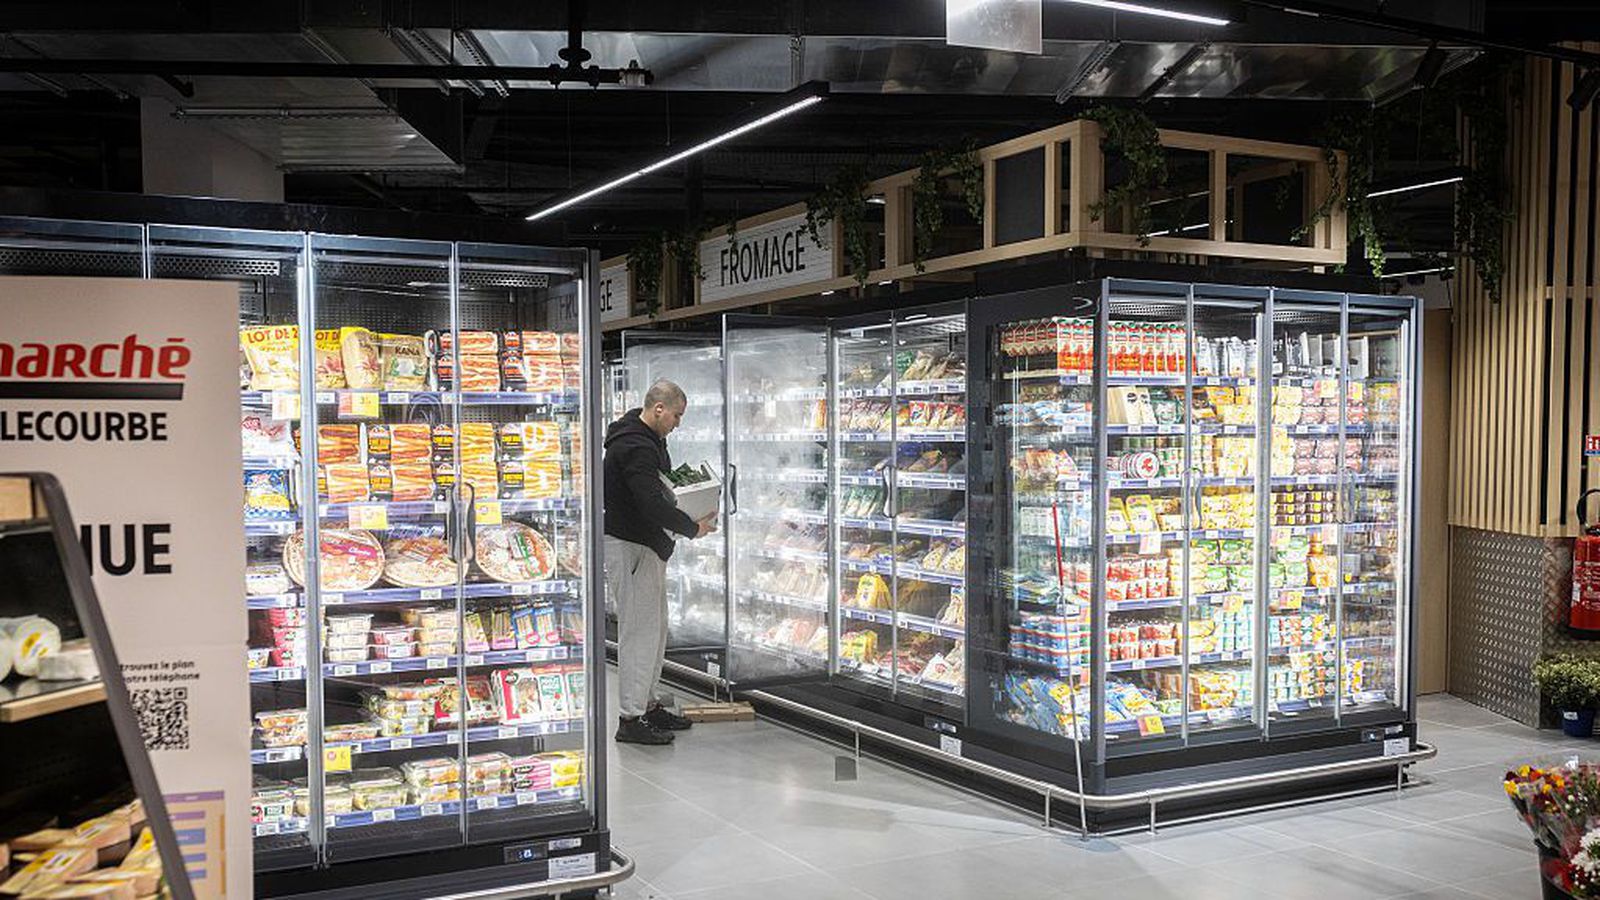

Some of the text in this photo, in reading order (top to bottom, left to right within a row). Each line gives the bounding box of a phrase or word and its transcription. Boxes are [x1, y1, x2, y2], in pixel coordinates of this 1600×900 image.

[719, 229, 806, 287] FROMAGE
[247, 328, 271, 344] LOT
[274, 328, 291, 341] DE
[1, 411, 168, 442] LECOURBE
[172, 660, 195, 671] plan
